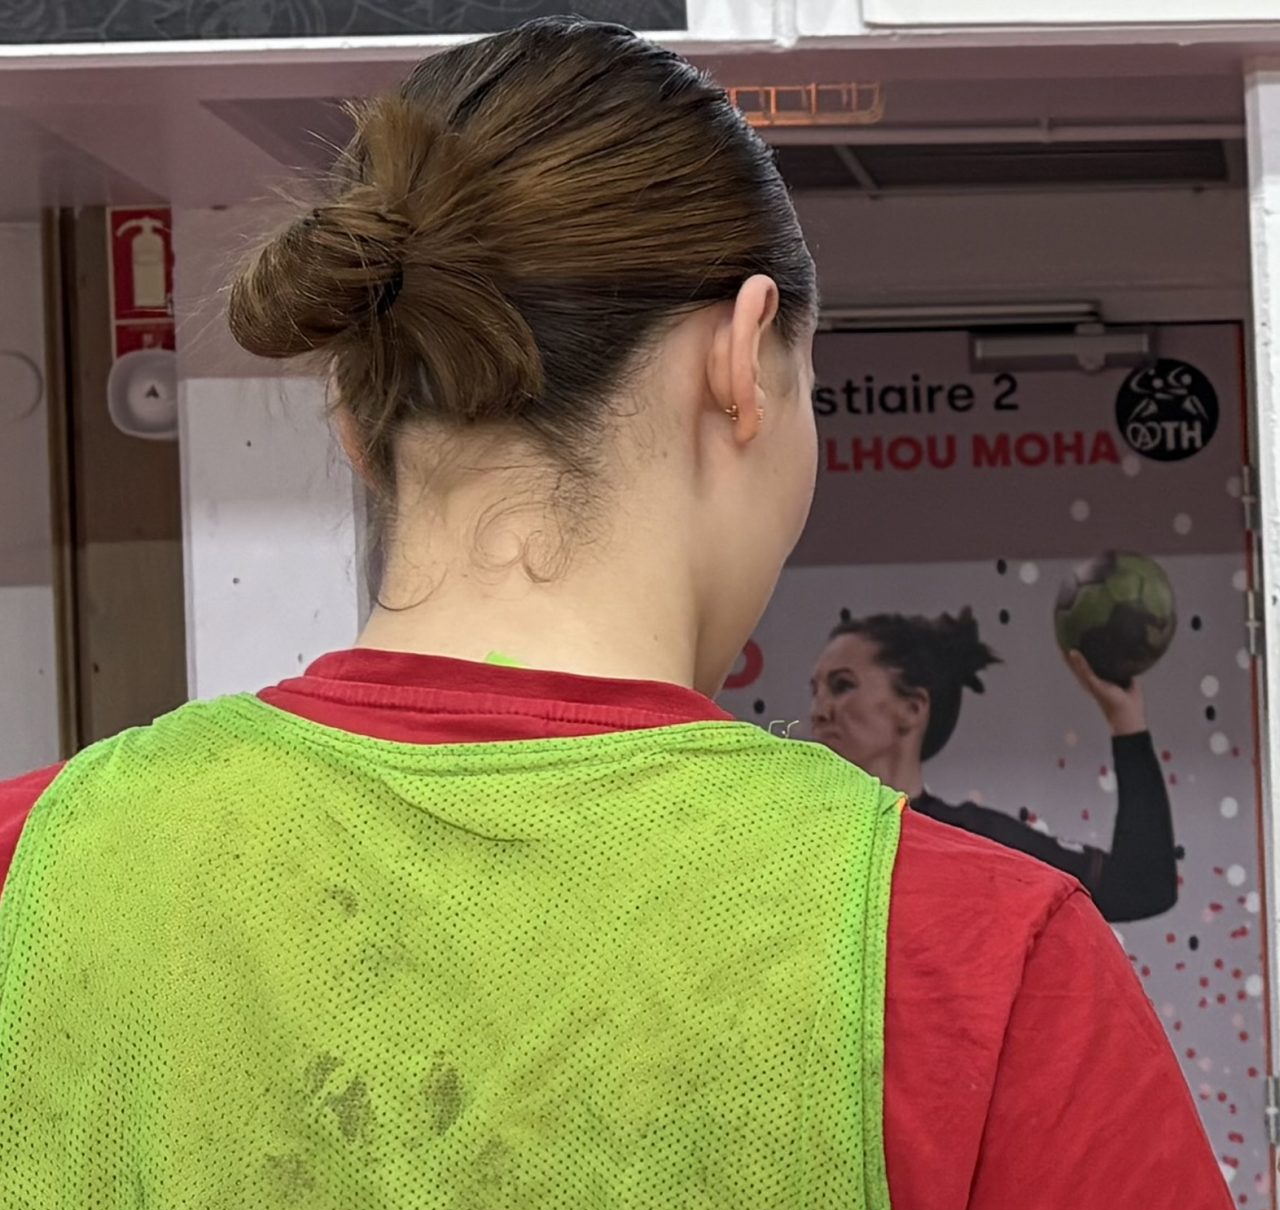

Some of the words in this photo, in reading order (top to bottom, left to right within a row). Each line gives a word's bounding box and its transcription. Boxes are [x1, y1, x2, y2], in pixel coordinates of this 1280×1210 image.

[993, 373, 1019, 411] 2
[826, 434, 956, 472] LHOU
[972, 431, 1122, 468] MOHA
